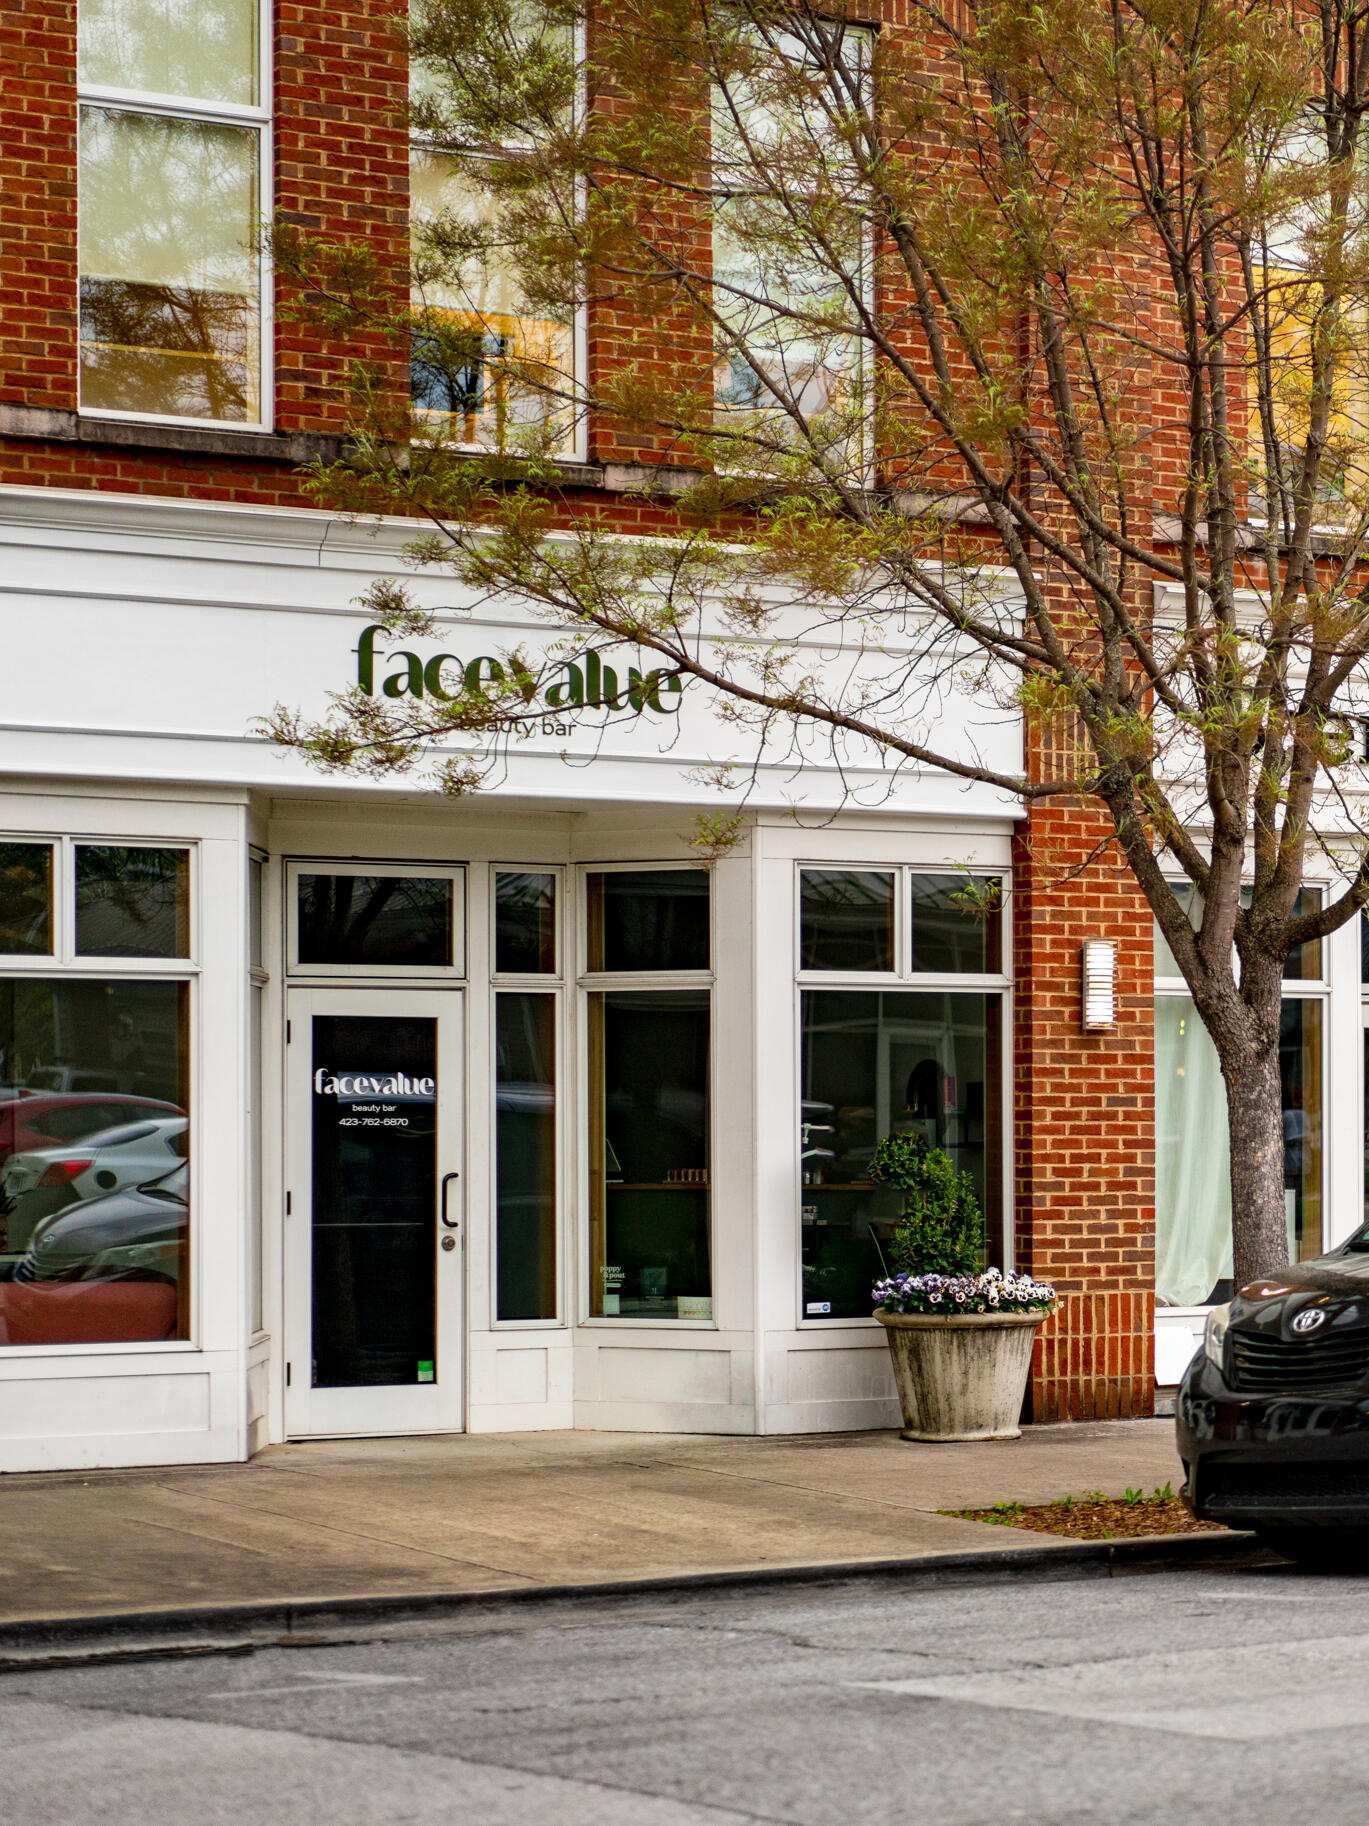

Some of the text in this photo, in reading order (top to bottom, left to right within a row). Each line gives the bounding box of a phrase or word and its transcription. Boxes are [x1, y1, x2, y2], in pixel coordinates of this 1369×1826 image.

[462, 717, 577, 738] auty bar
[313, 1067, 435, 1095] facevalue
[352, 1104, 397, 1113] beauty bar
[338, 1118, 409, 1126] 423-762-6870
